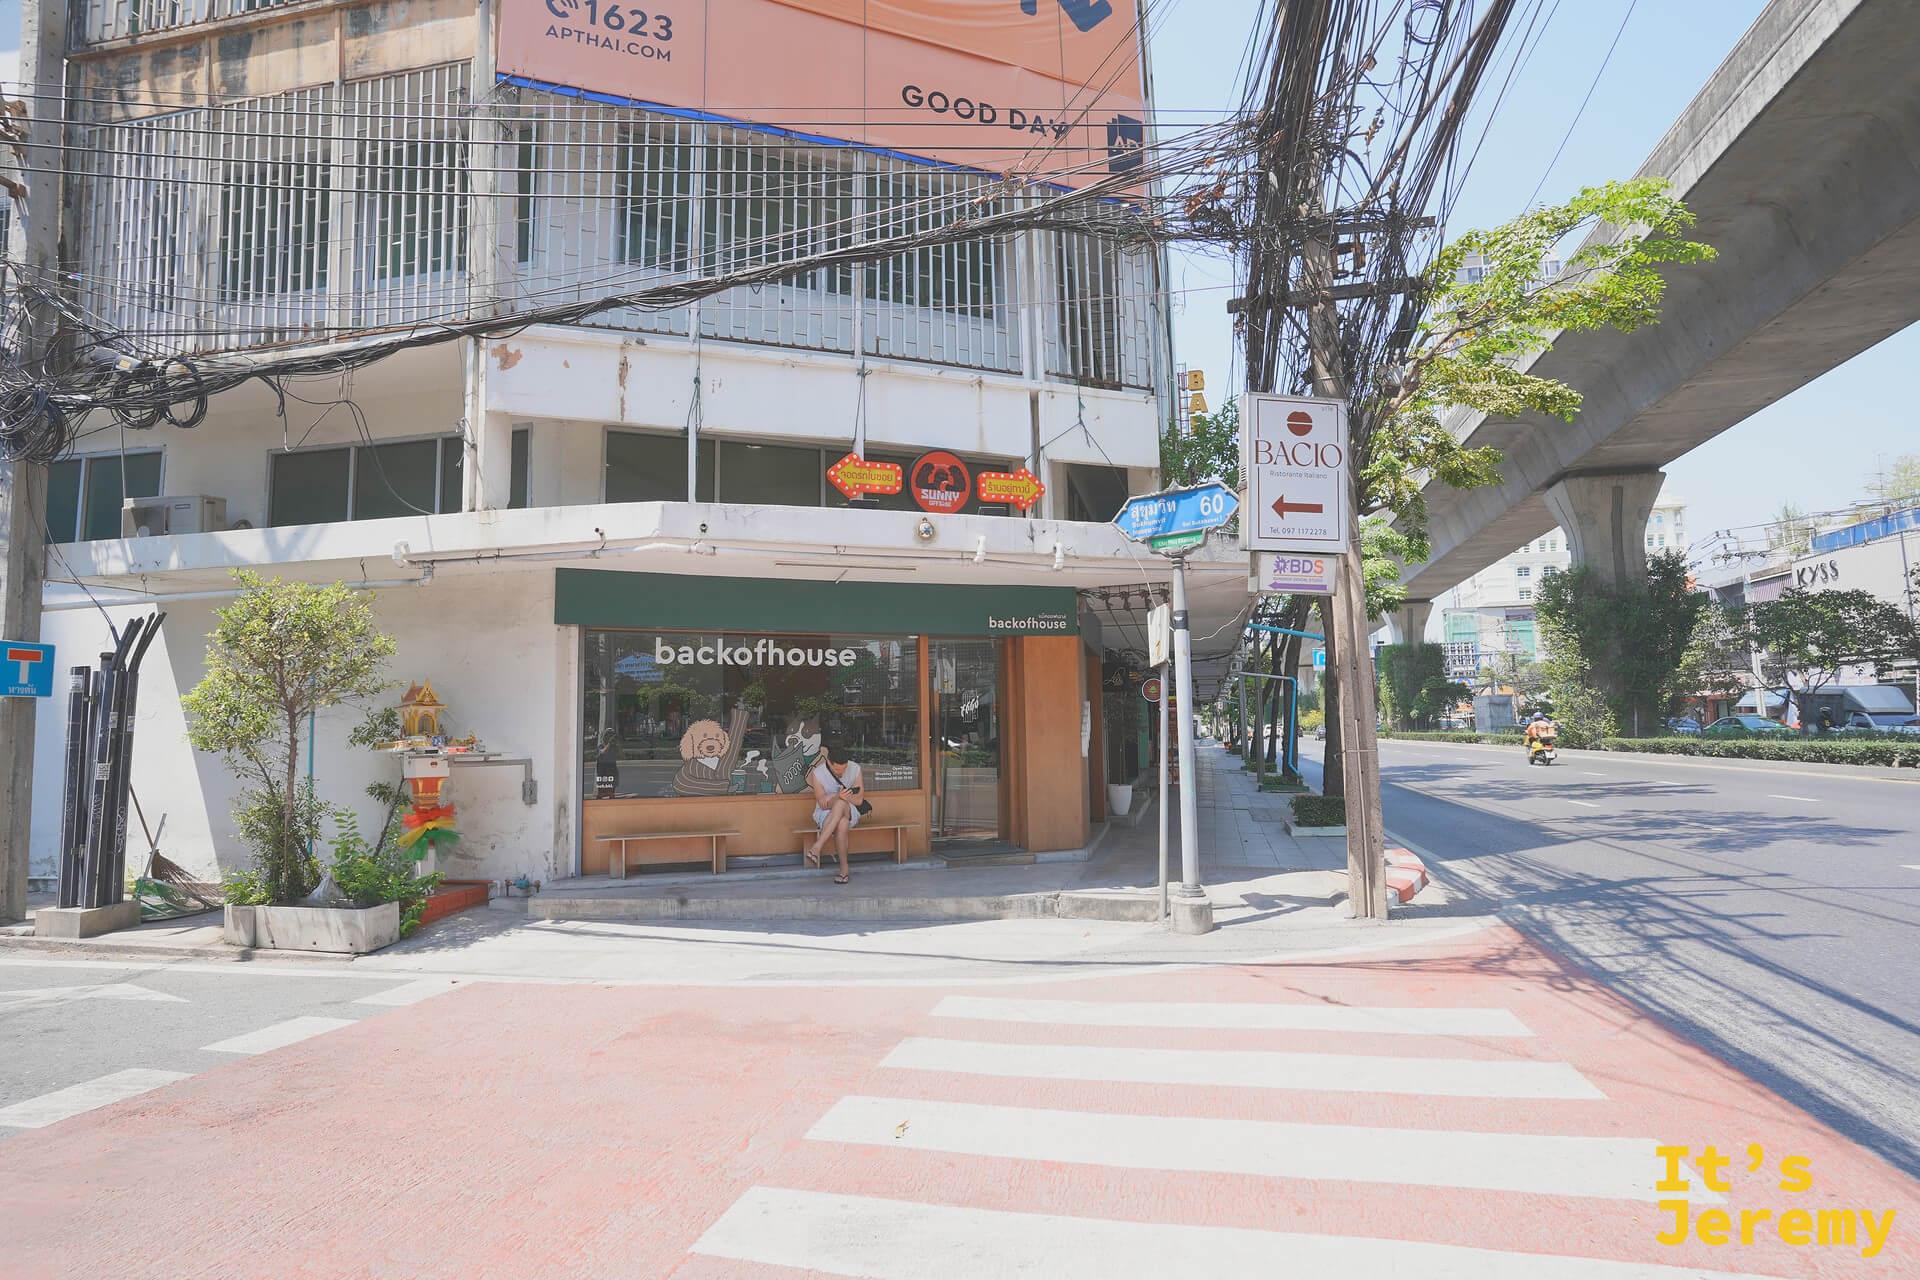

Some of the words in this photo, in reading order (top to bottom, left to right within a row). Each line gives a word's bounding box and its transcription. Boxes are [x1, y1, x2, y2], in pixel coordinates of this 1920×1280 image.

[585, 0, 673, 41] 1623
[545, 24, 671, 62] APTHAI.COM
[901, 85, 997, 124] GOOD
[1009, 108, 1070, 140] DAY
[1255, 439, 1343, 469] BACIO
[1270, 469, 1303, 479] Ristorante
[921, 488, 960, 502] SUNNY
[1200, 493, 1224, 516] 60
[1131, 498, 1177, 521] สุขุมวิท
[1282, 527, 1295, 536] 097
[1298, 528, 1327, 536] 1172278
[1290, 559, 1325, 575] BDS
[1797, 559, 1839, 586] KYSS
[989, 616, 1067, 629] backofhouse
[656, 636, 857, 667] backofhouse
